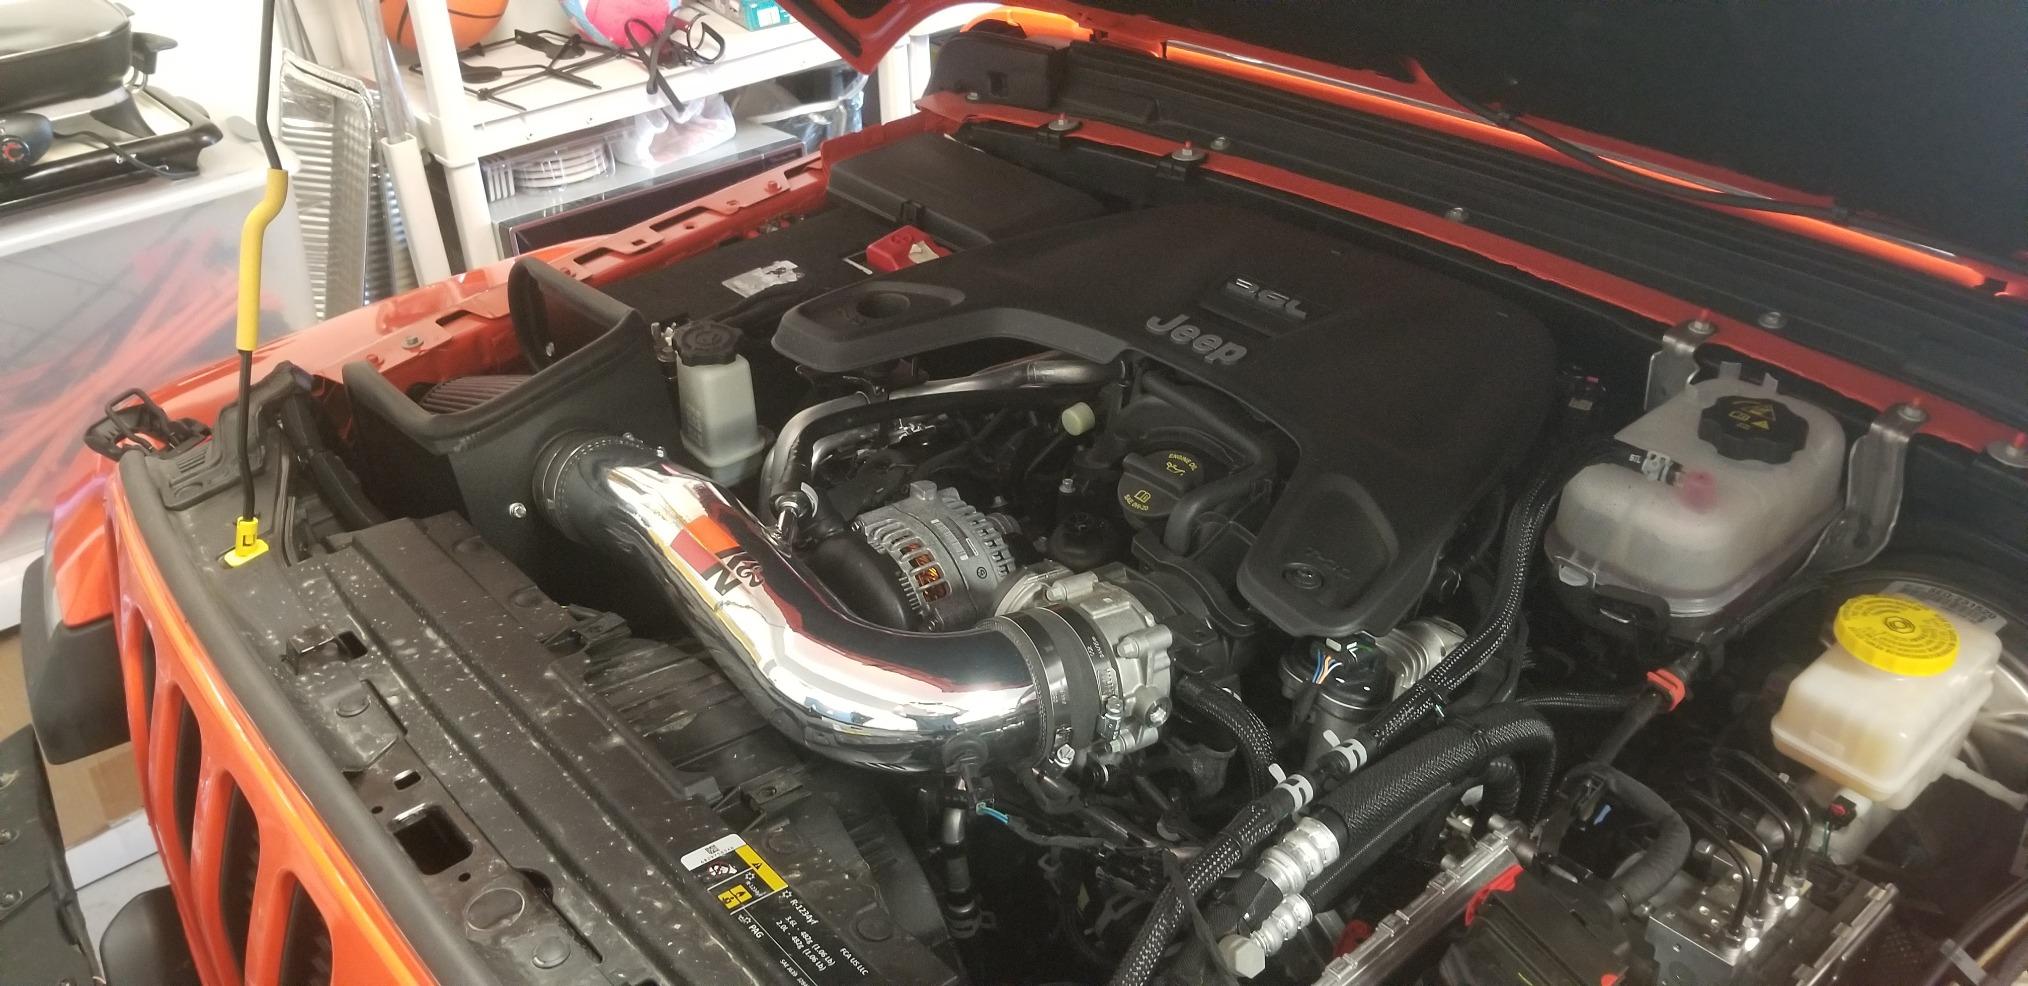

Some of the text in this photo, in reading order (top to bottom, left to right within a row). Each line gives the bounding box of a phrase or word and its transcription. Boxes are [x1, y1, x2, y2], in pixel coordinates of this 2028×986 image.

[1146, 314, 1248, 365] Jeep
[1168, 453, 1192, 464] ENGINE
[790, 899, 819, 925] R-1234yf
[748, 923, 764, 939] PAG
[776, 920, 789, 932] 2.0L
[802, 948, 819, 963] (1.06
[811, 943, 828, 958] (1.06
[840, 947, 869, 976] FCA US LLC
